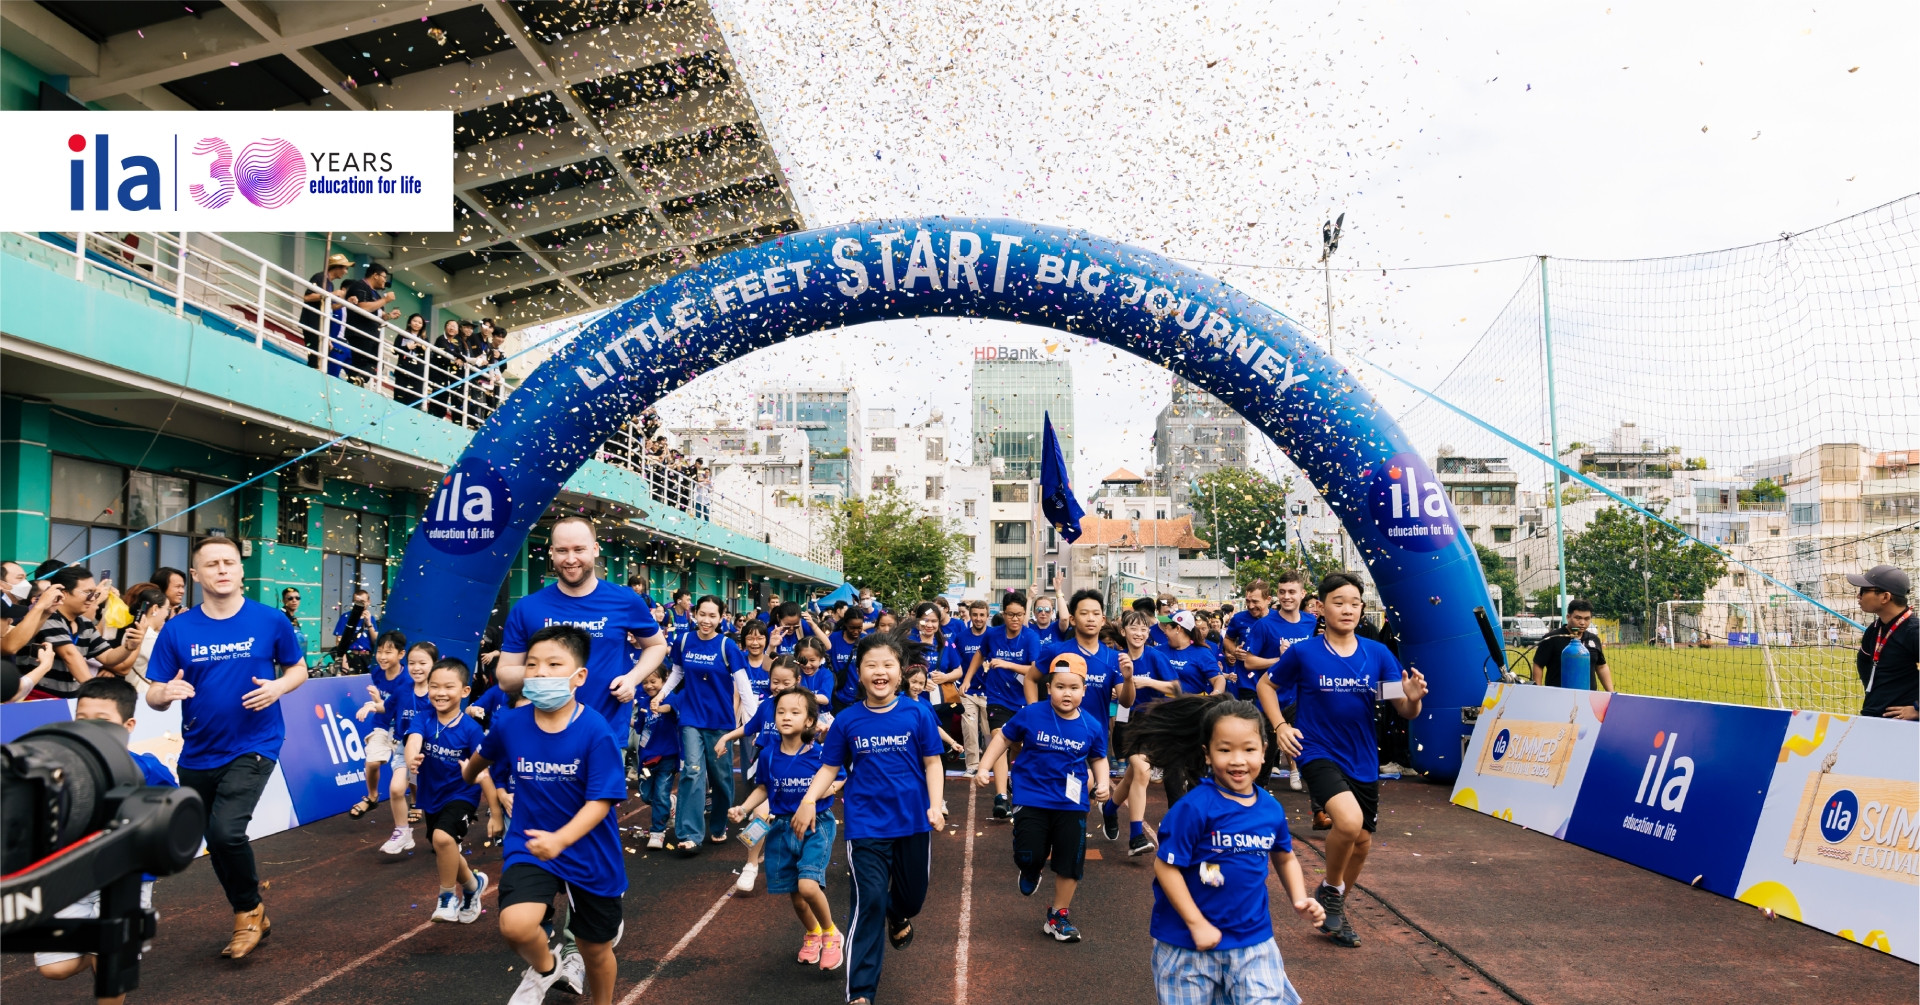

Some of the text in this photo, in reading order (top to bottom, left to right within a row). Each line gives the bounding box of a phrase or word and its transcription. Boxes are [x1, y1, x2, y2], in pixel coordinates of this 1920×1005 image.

[575, 229, 1310, 393] LITTLE FEET START BIG JOURNEY
[974, 345, 1038, 361] HDBank
[435, 472, 493, 522] ila
[1388, 467, 1449, 519] ila
[429, 527, 495, 539] education for life
[1388, 523, 1454, 537] education for life
[190, 641, 252, 656] ila SUMMER
[210, 653, 231, 661] Never
[1319, 675, 1333, 686] ila
[315, 703, 365, 765] ila
[854, 735, 908, 749] ila SUMMER
[1036, 730, 1050, 742] ila
[1494, 735, 1507, 755] ila
[1508, 733, 1558, 763] SUMMER
[517, 757, 578, 775] ila SUMMER
[1635, 730, 1695, 813] ila
[1825, 801, 1852, 832] ila
[1622, 813, 1677, 842] education for life
[1211, 830, 1275, 850] ila SUMMER
[1853, 845, 1919, 877] FESTIVAL
